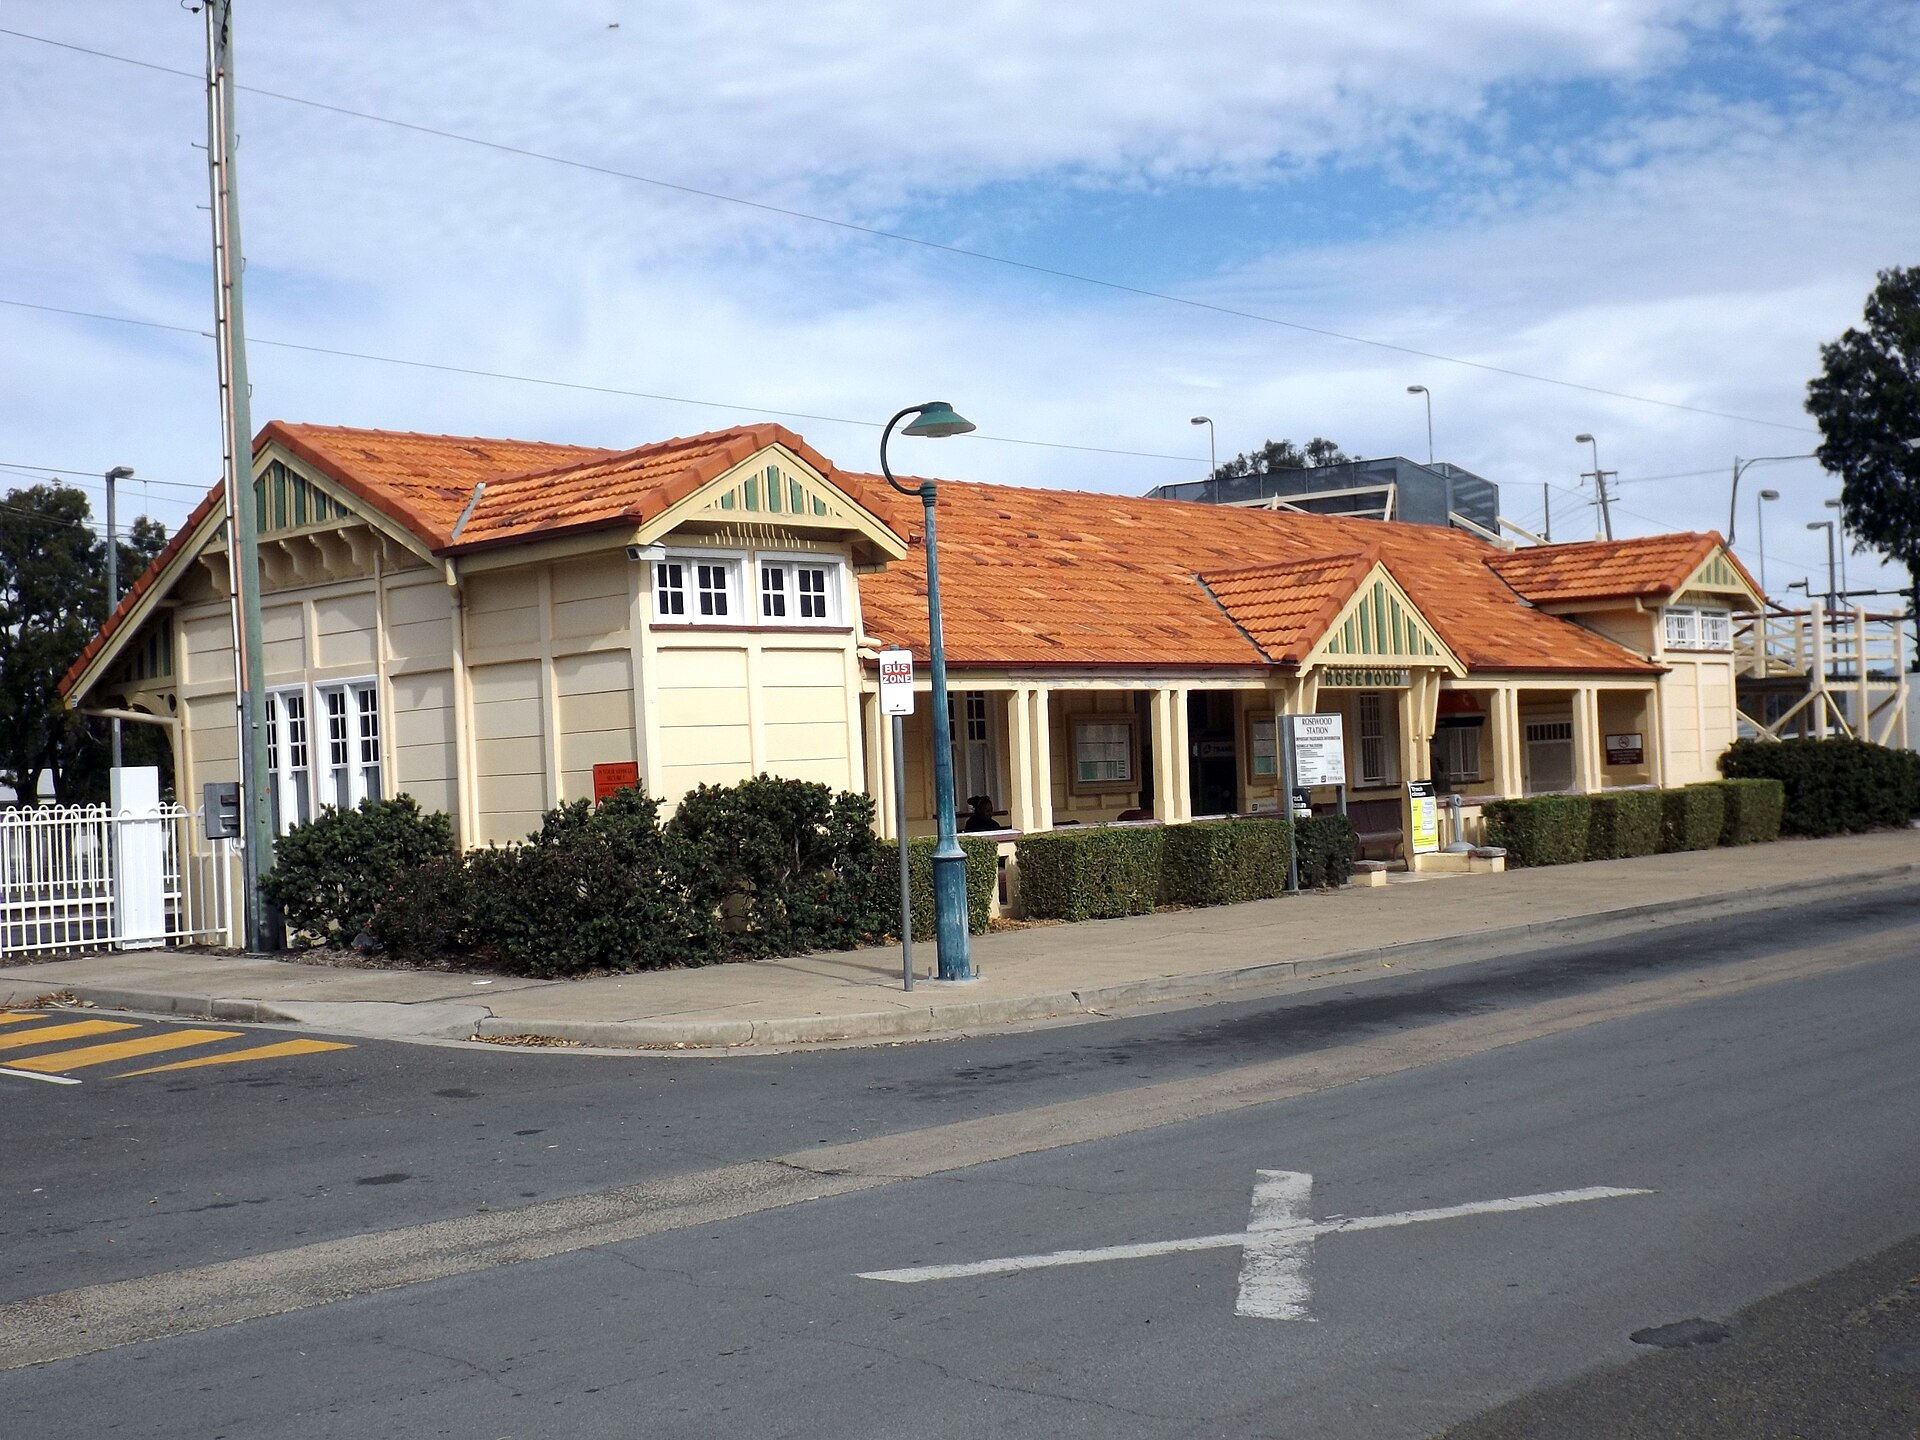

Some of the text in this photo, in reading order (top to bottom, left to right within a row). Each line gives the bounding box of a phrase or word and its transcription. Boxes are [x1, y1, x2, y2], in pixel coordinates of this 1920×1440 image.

[884, 664, 908, 673] BUS
[882, 674, 911, 684] ZONE
[1325, 670, 1401, 686] ROSEWOOD
[1301, 717, 1333, 726] ROSEWOOD
[1306, 726, 1329, 735] STATION
